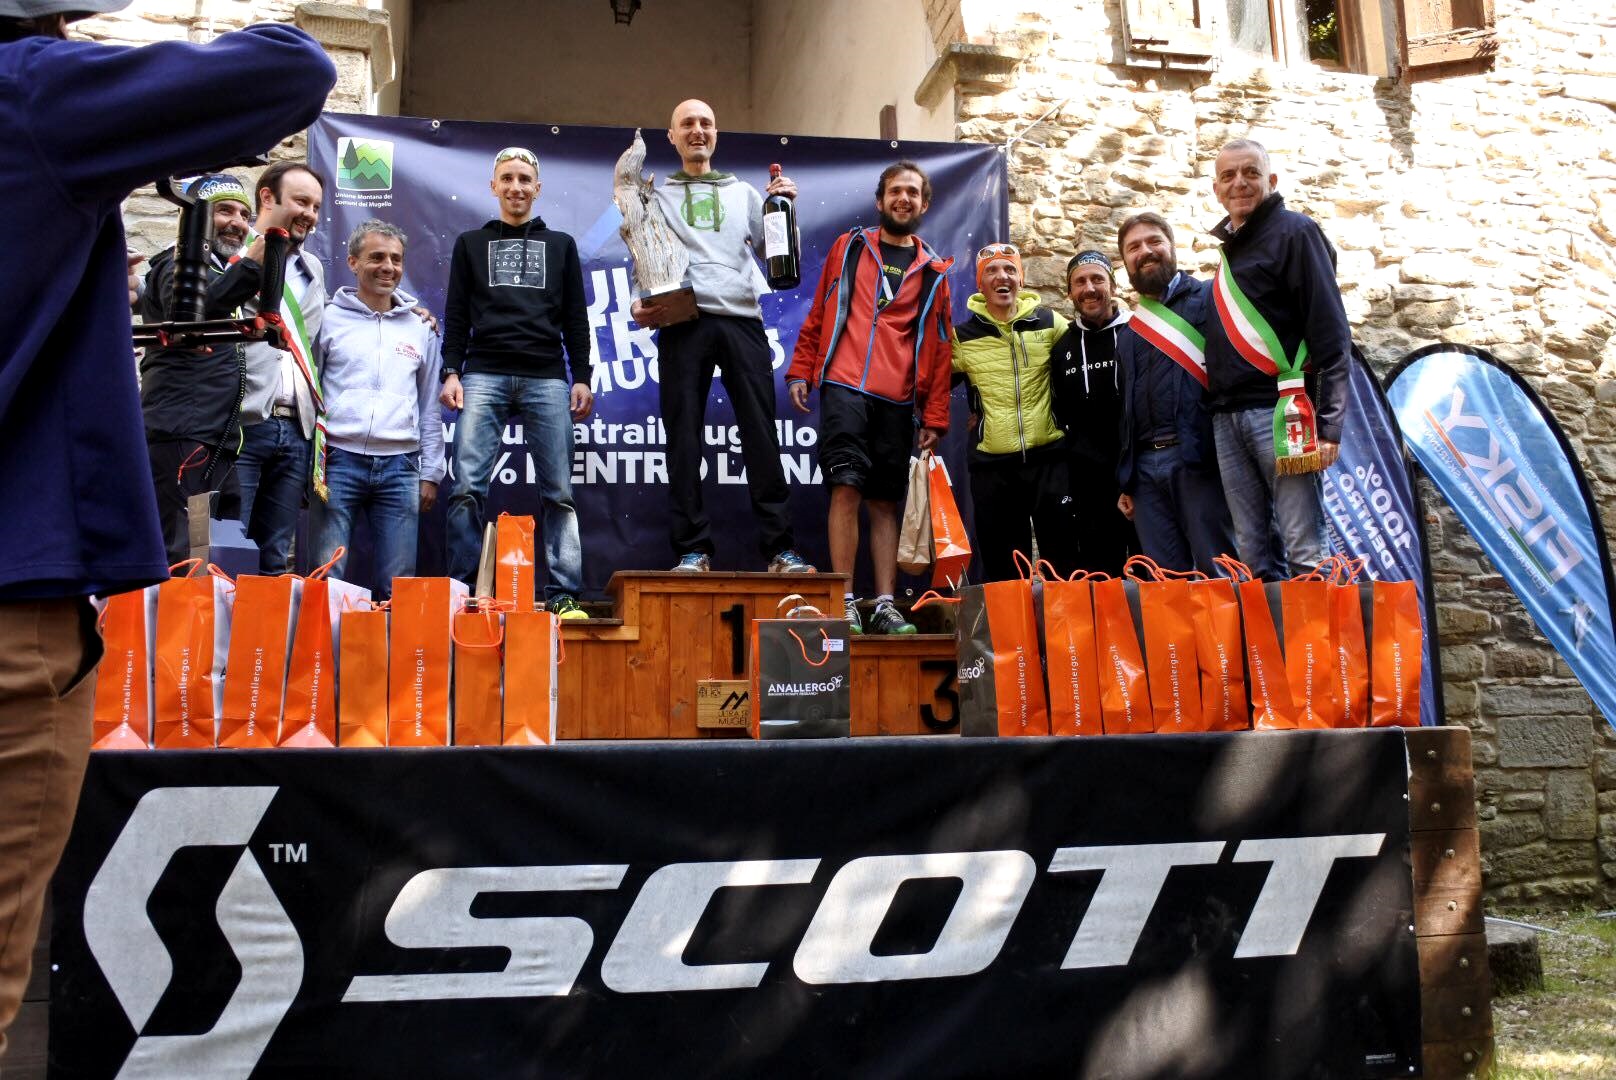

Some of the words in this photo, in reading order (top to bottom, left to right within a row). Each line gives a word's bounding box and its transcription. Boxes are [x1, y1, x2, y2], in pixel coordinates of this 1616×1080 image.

[368, 201, 392, 209] Mugello
[1065, 366, 1077, 376] NO
[1081, 359, 1114, 372] SHORT
[720, 604, 744, 675] 1
[120, 650, 134, 738] www.anallergo.it
[178, 647, 190, 737] www.anallergo.it
[247, 647, 263, 736] www.anallergo.it
[308, 651, 321, 737] www.anallergo.it
[415, 648, 424, 737] www.anallergo.it
[767, 682, 836, 693] ANALLERGO
[919, 660, 960, 731] 3
[1016, 645, 1028, 727] www.anallergo.it
[1068, 645, 1081, 727] www.anallergo.it
[1168, 643, 1182, 724] www.anallergo.it
[1305, 643, 1313, 721] www.anallergo.it
[269, 843, 308, 863] TM
[341, 832, 1386, 1003] SCOTT
